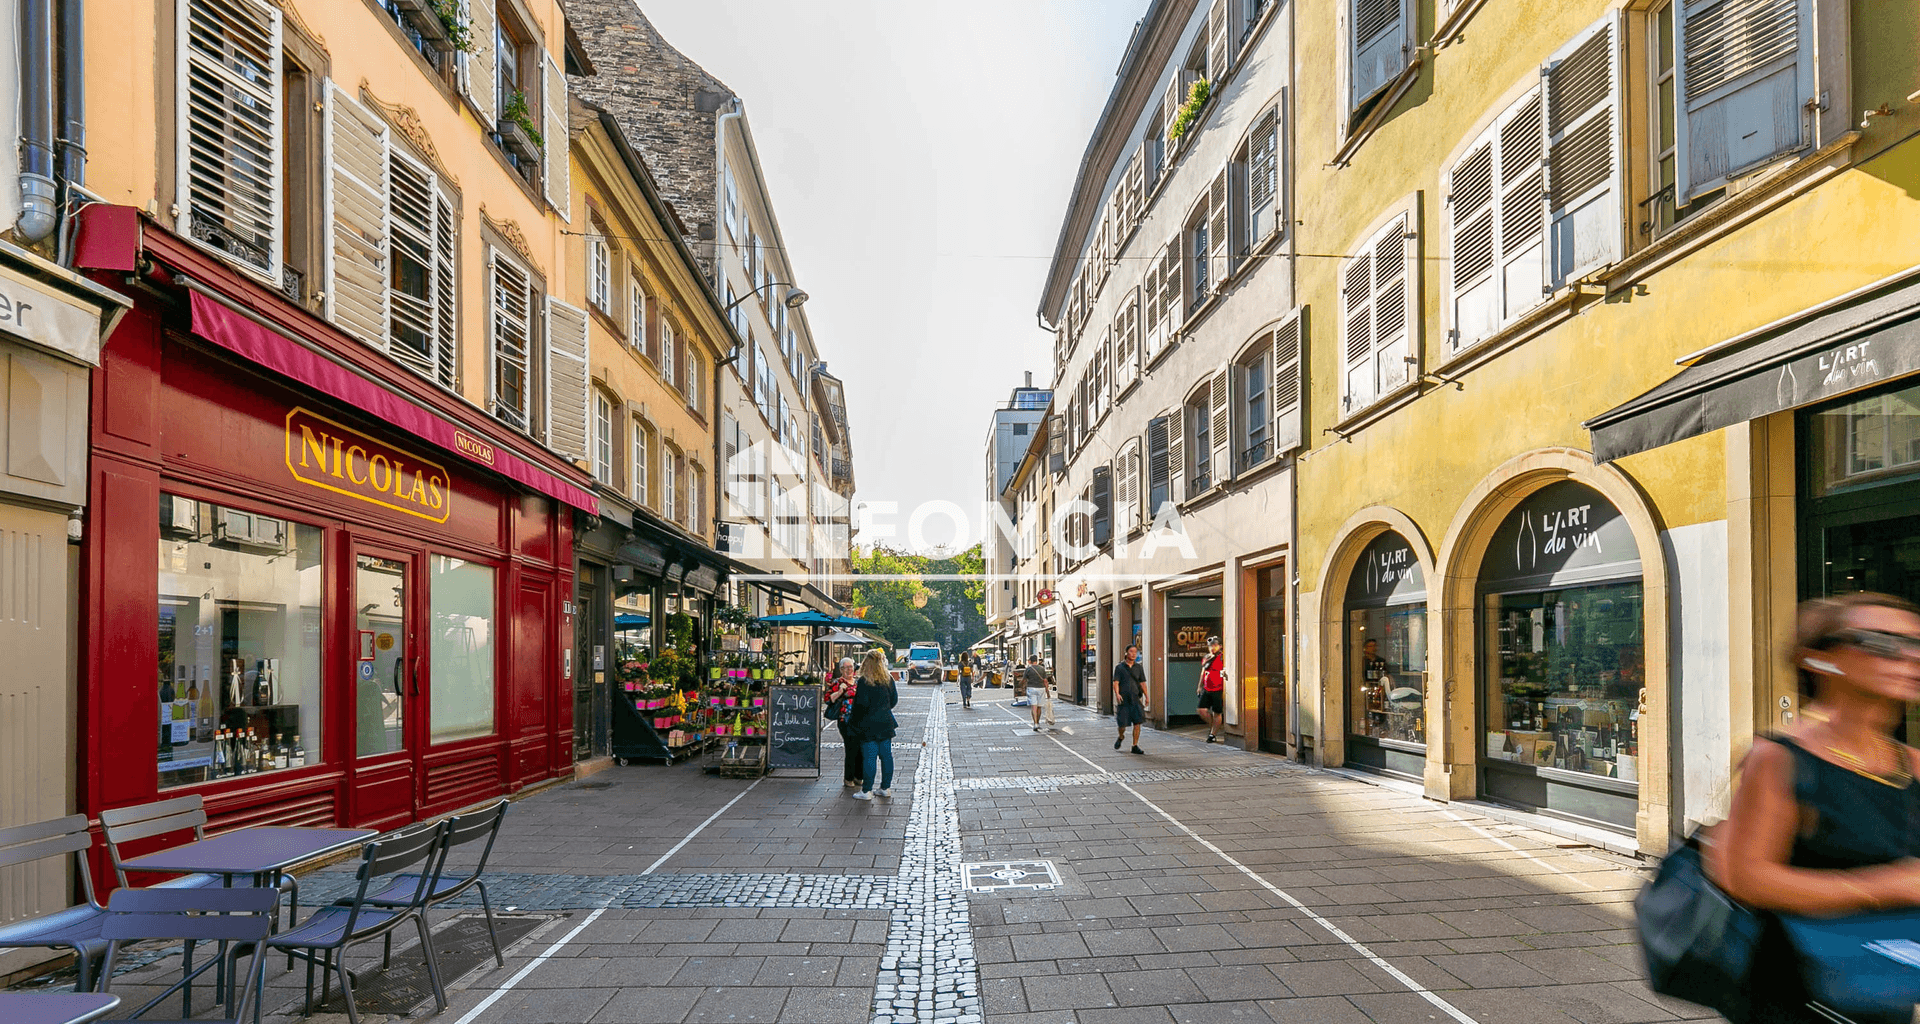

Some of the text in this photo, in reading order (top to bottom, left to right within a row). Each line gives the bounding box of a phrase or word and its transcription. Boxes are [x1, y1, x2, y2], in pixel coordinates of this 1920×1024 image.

[1818, 341, 1871, 371] L'ART
[1850, 357, 1880, 376] vin
[457, 435, 493, 461] NICOLAS
[298, 423, 443, 510] NICOLAS
[1543, 503, 1591, 532] L'ART
[717, 530, 744, 547] happy
[1543, 524, 1602, 555] du vin
[1381, 548, 1408, 567] L'ART
[1382, 562, 1414, 585] du vin
[194, 624, 213, 636] 2+1
[1177, 631, 1208, 646] QUIZ
[776, 694, 814, 711] 4.90€
[774, 731, 785, 748] 5
